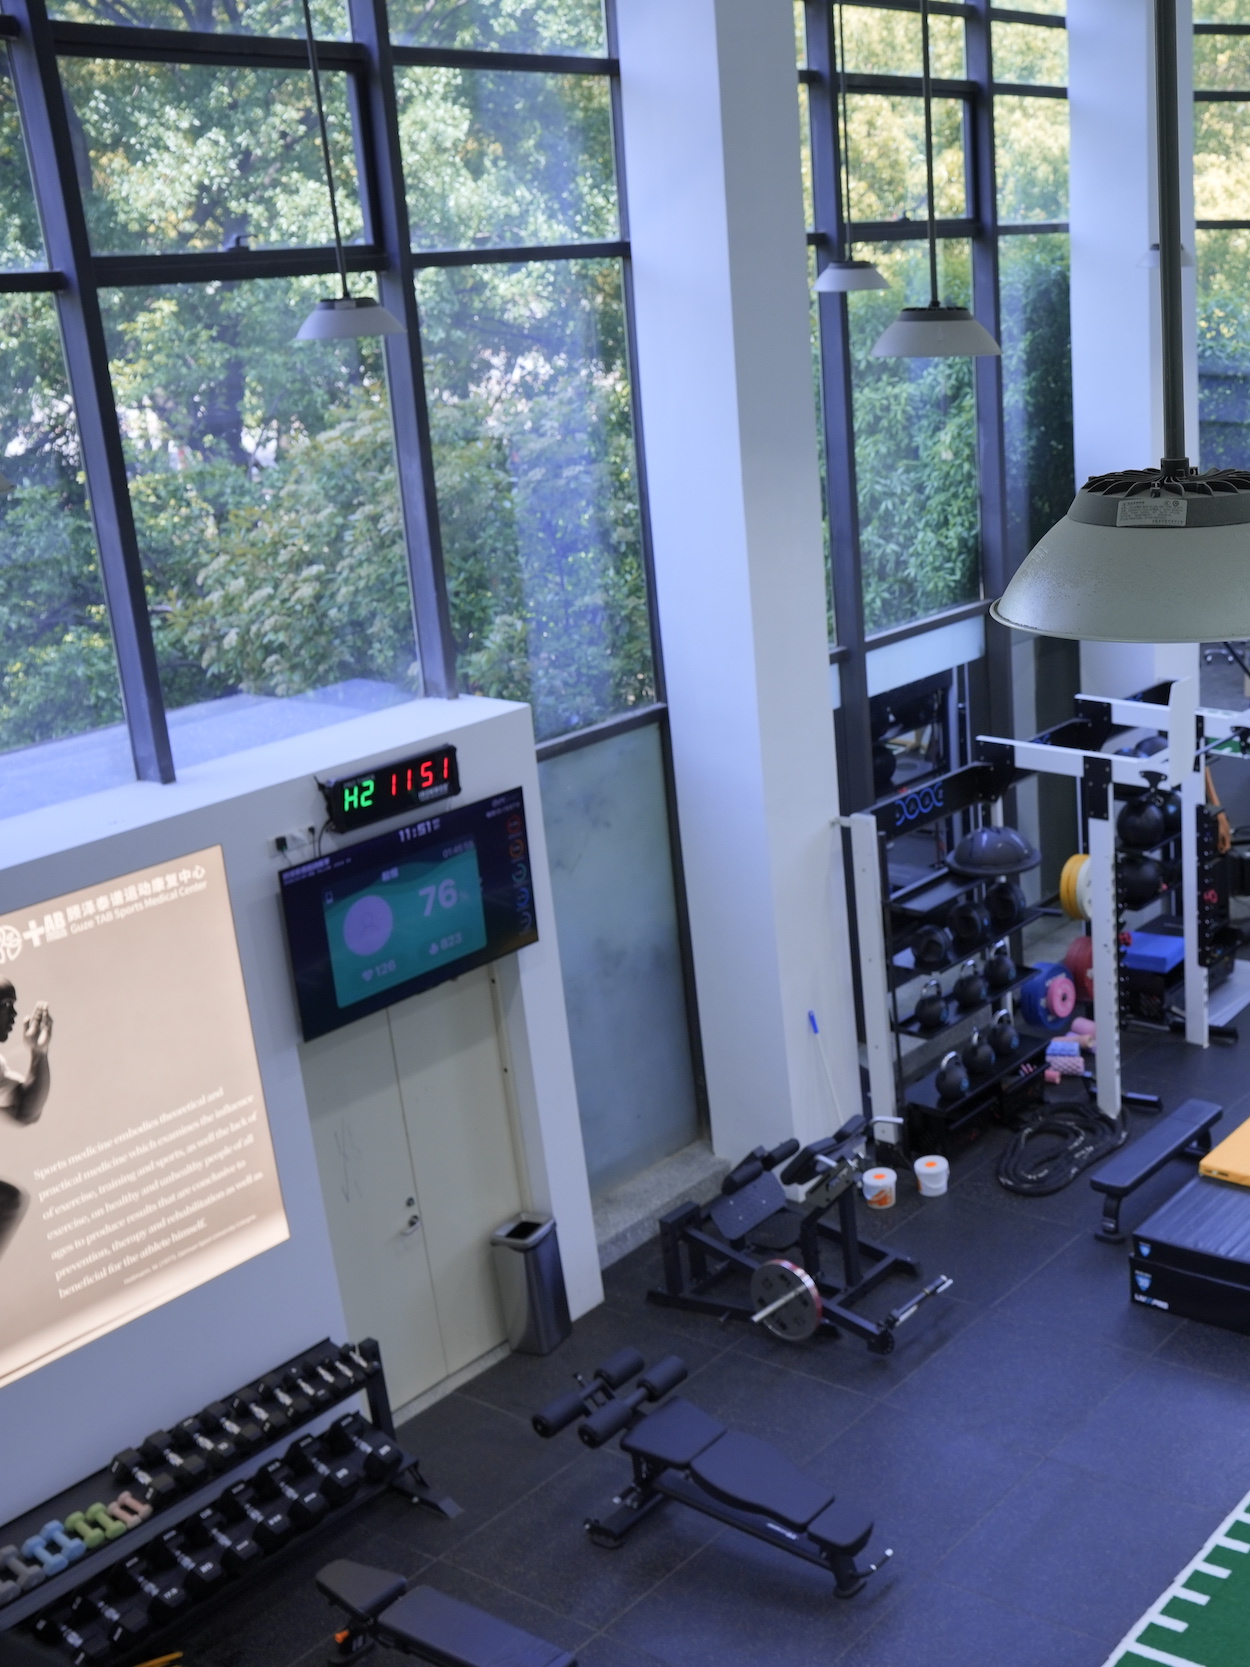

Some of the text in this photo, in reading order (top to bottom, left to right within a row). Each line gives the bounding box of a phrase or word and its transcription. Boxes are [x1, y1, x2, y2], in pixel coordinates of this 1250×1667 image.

[343, 779, 375, 812] H2
[391, 757, 449, 796] 1151
[70, 919, 95, 935] Guze
[114, 902, 145, 919] Sports
[144, 888, 179, 909] Medical
[179, 880, 208, 897] Center
[418, 878, 458, 917] 76
[33, 1086, 224, 1181] Sports medicine embodies theoretical and
[39, 1172, 82, 1203] practical
[83, 1154, 128, 1180] medicine
[128, 1139, 157, 1159] which
[157, 1120, 200, 1146] examines
[200, 1113, 214, 1126] the
[43, 1205, 54, 1221] of
[98, 1171, 137, 1195] training
[137, 1160, 155, 1177] and
[196, 1132, 215, 1148] well
[215, 1126, 230, 1140] the
[247, 1110, 257, 1124] of
[91, 1207, 104, 1219] on
[104, 1191, 139, 1213] healthy
[141, 1179, 159, 1197] and
[160, 1161, 203, 1187] unhealthy
[204, 1145, 232, 1168] people
[51, 1243, 74, 1260] ages
[74, 1238, 85, 1249] to
[85, 1218, 125, 1246] produce
[126, 1203, 157, 1224] results
[157, 1193, 176, 1209] that
[111, 1228, 147, 1252] therapy
[147, 1217, 166, 1234] and
[59, 1266, 108, 1299] beneficial
[108, 1262, 122, 1275] for
[123, 1253, 139, 1267] the
[139, 1237, 171, 1259] athlete
